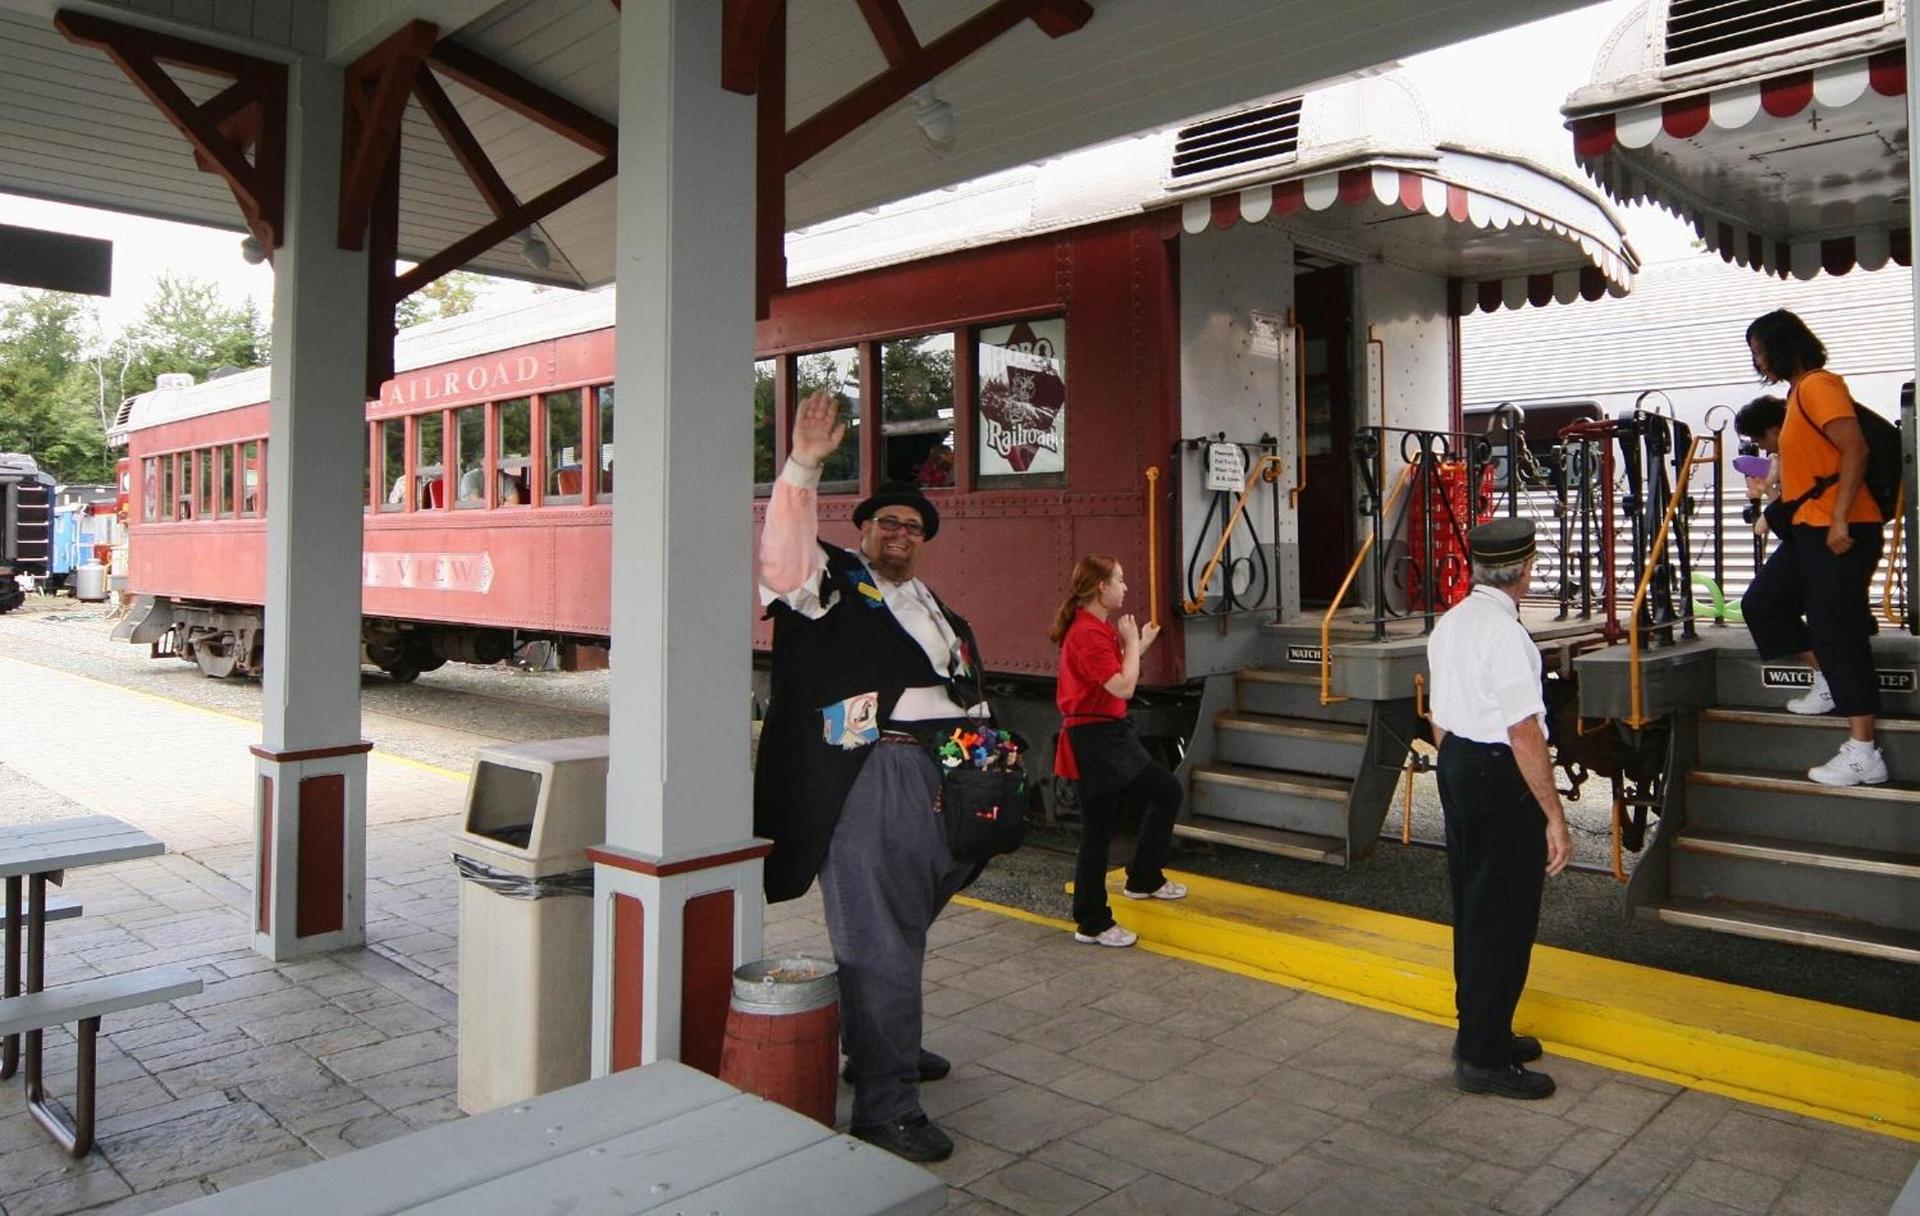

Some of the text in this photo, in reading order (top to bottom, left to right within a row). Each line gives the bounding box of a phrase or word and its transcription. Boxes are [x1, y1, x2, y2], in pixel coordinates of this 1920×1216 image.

[988, 419, 1058, 458] Railroad
[397, 559, 474, 583] VIEW
[1291, 649, 1321, 659] WATCH
[1768, 671, 1910, 687] WATCH TEP
